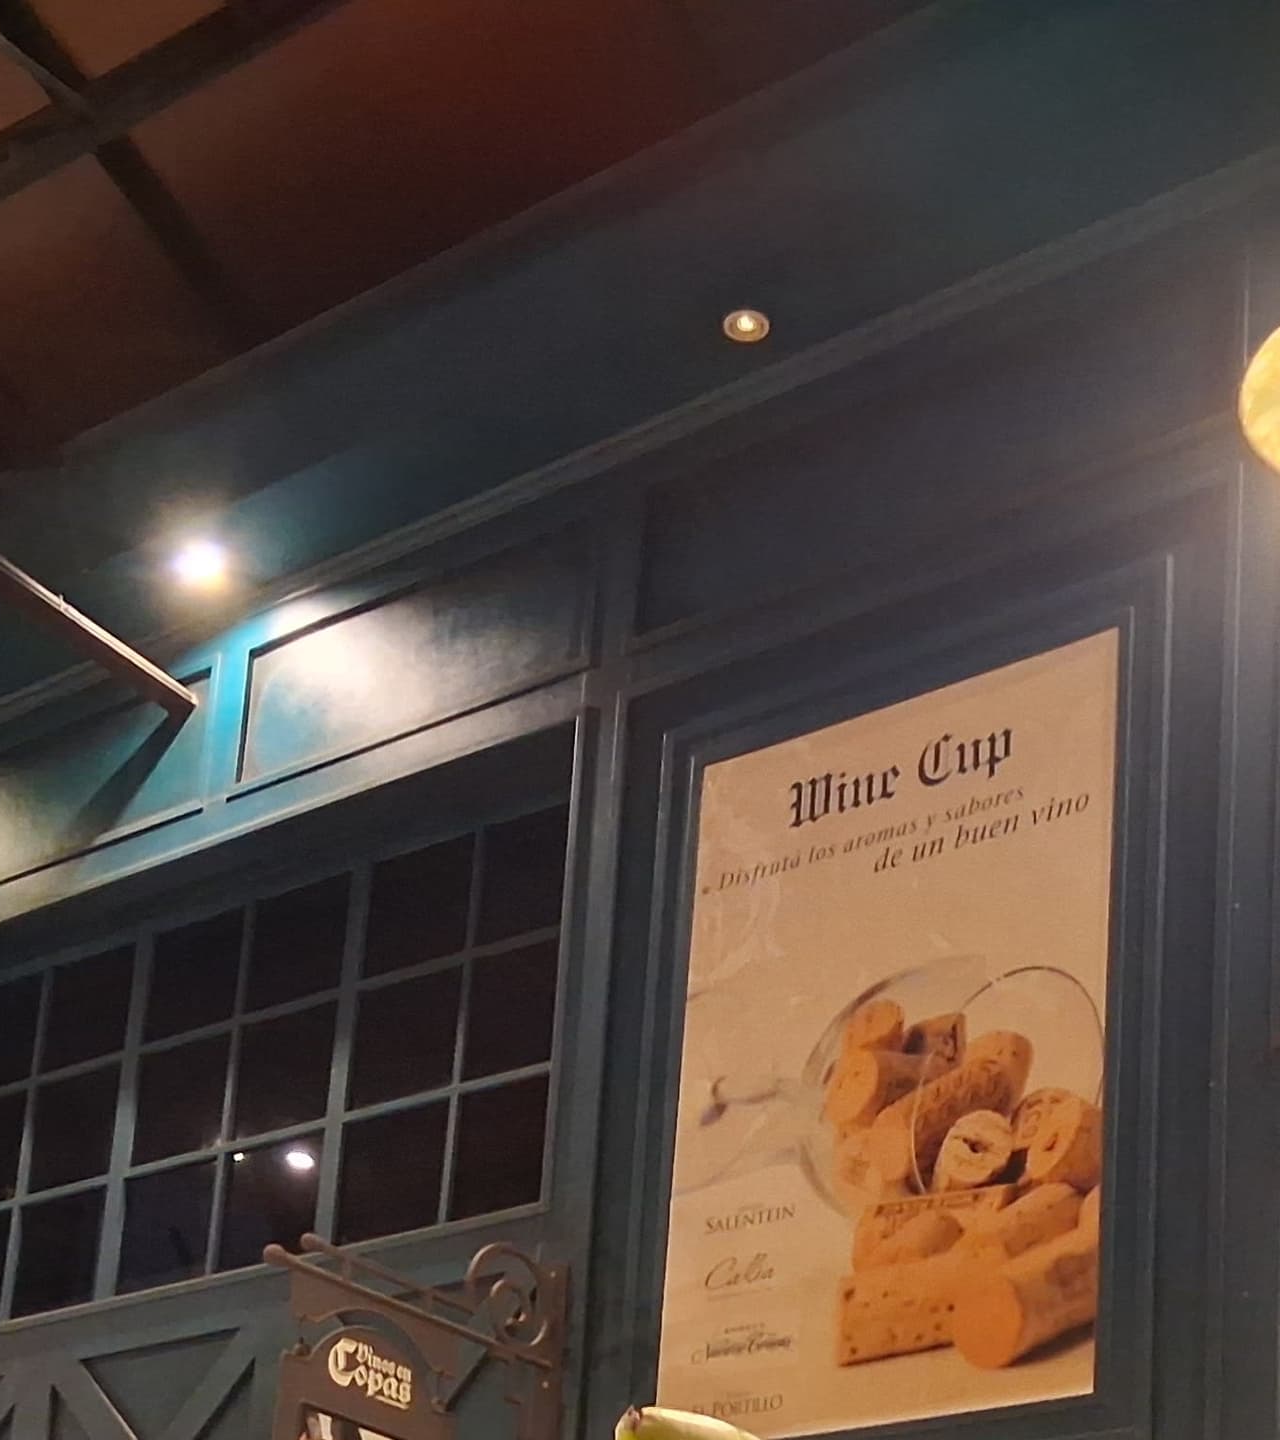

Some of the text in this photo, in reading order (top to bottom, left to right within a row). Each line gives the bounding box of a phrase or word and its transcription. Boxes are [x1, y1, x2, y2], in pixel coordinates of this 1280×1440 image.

[789, 727, 1014, 829] Wine Cup
[807, 842, 837, 865] los
[842, 821, 919, 855] aromas
[923, 811, 938, 833] y
[943, 785, 1025, 824] sabores
[872, 791, 1091, 874] de un buen vino
[327, 1336, 412, 1404] Copas
